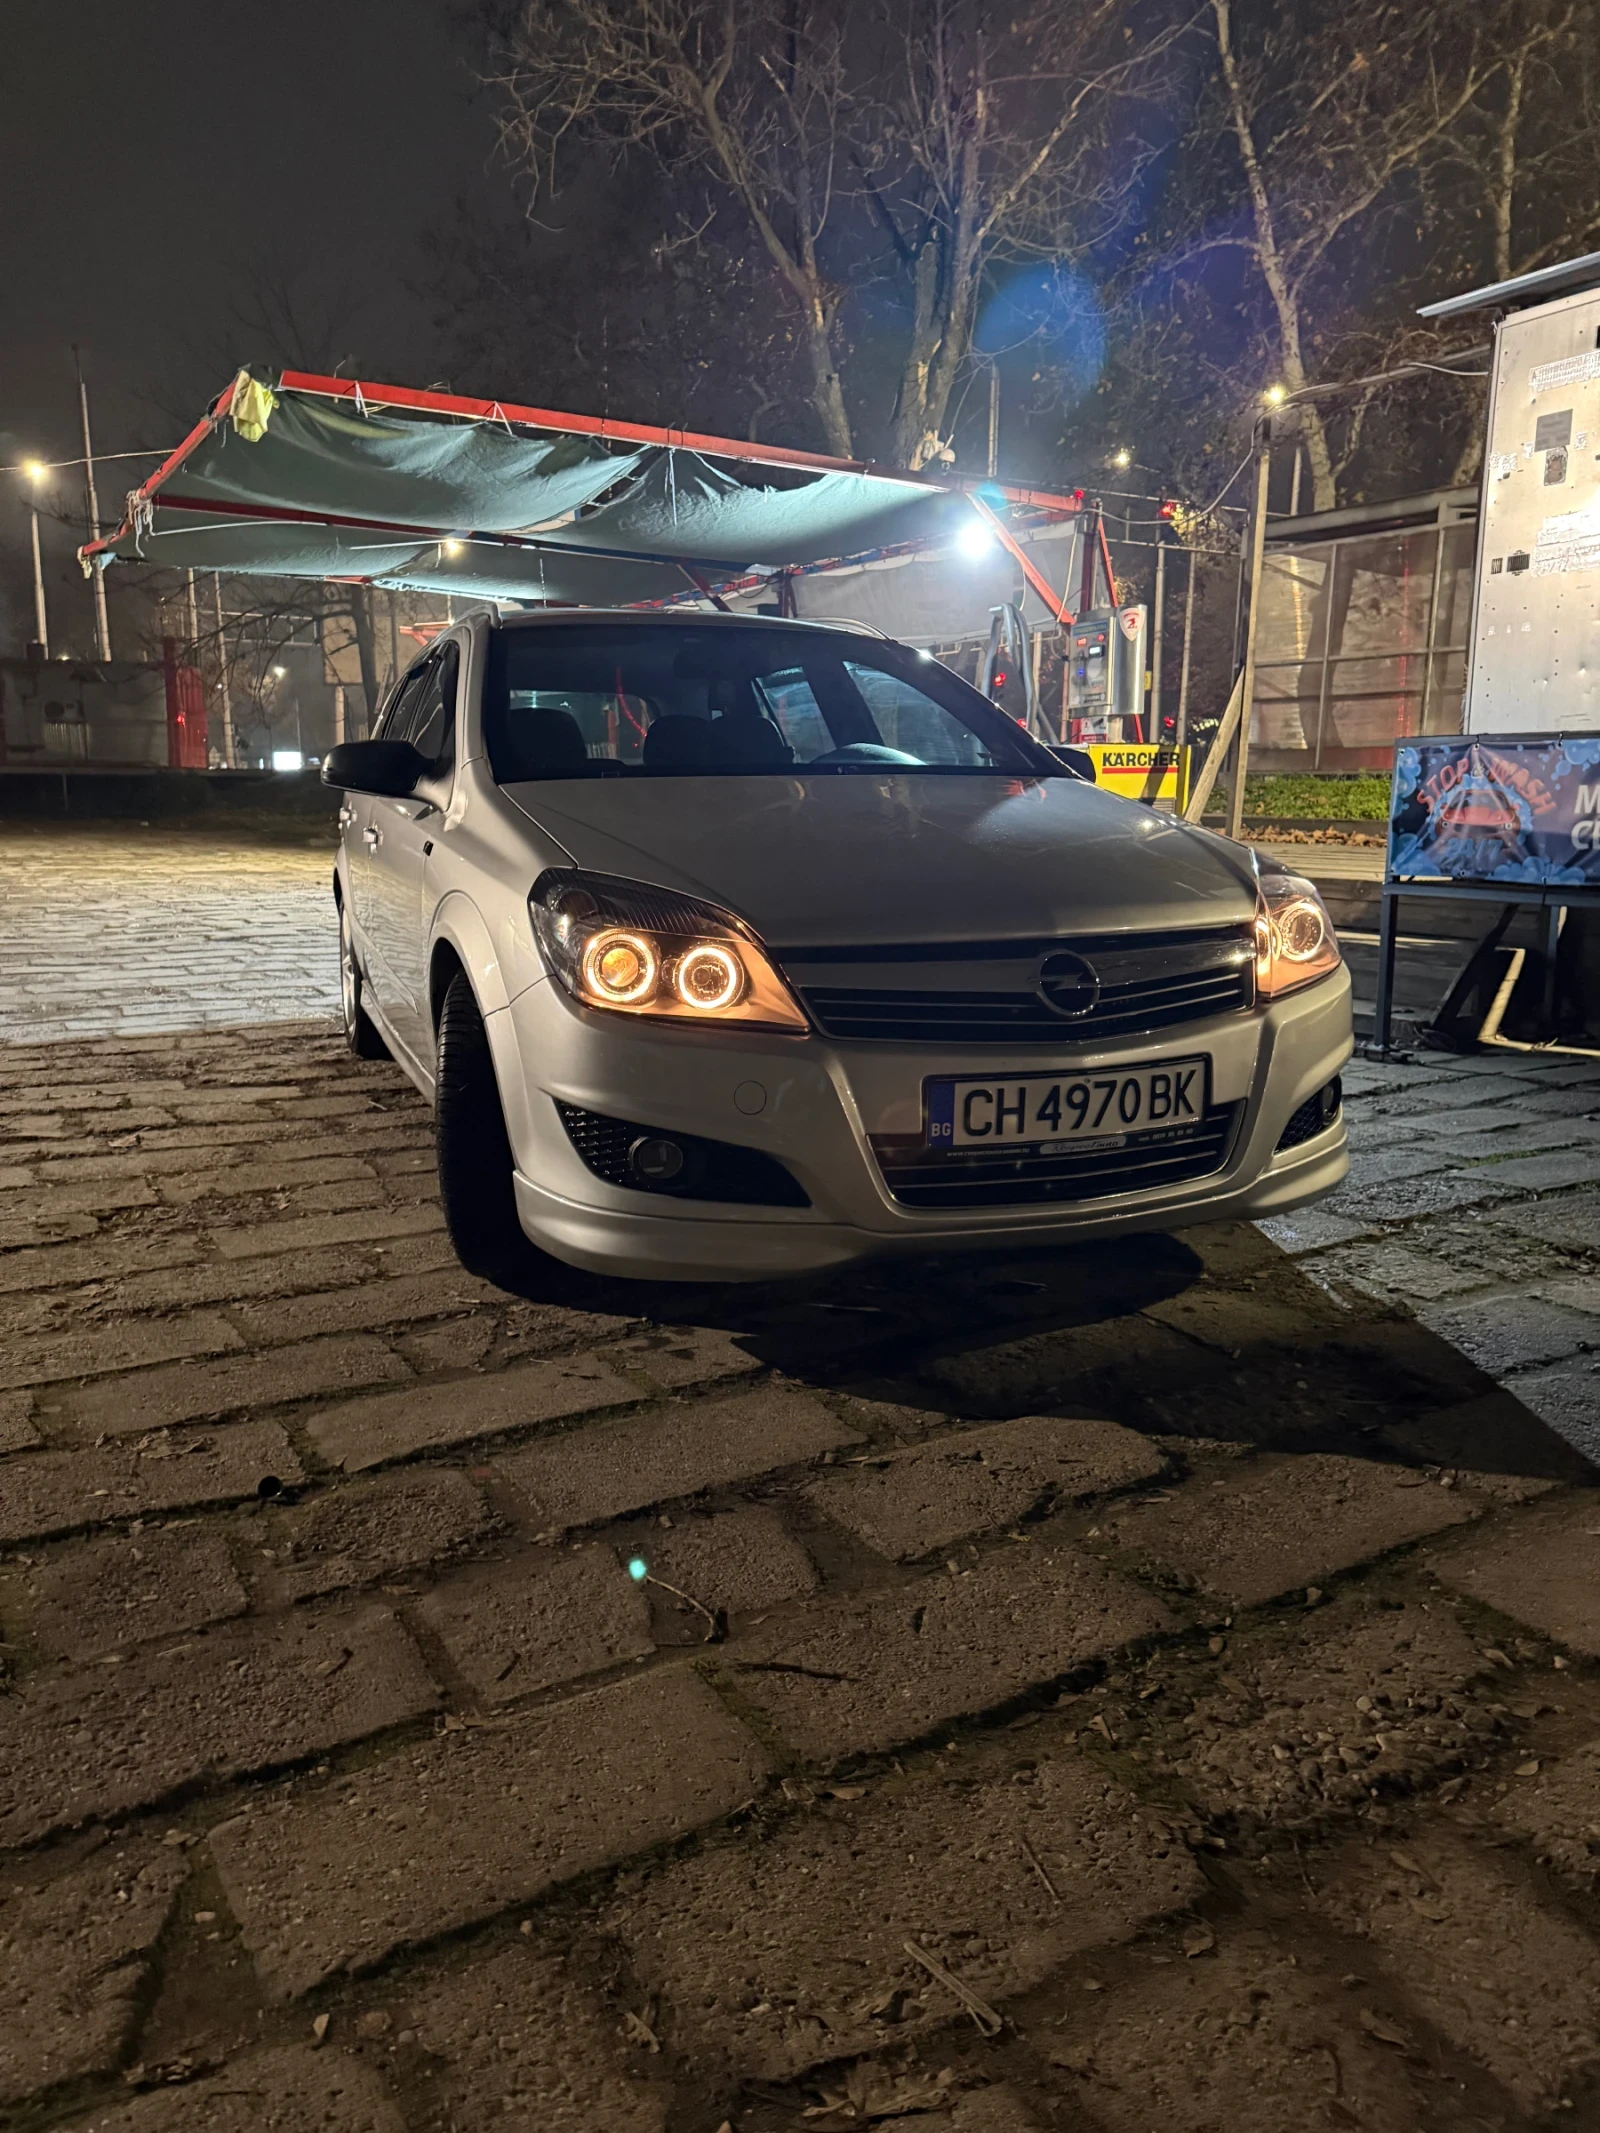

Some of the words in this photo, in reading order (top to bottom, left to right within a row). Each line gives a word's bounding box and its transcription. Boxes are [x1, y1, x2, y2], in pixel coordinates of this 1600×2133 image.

[1102, 752, 1180, 767] KÄRCHER
[1416, 757, 1470, 813] STOP
[963, 1086, 1027, 1137] CH
[1036, 1078, 1142, 1132] 4970
[1149, 1069, 1198, 1121] BK
[931, 1123, 951, 1138] BG
